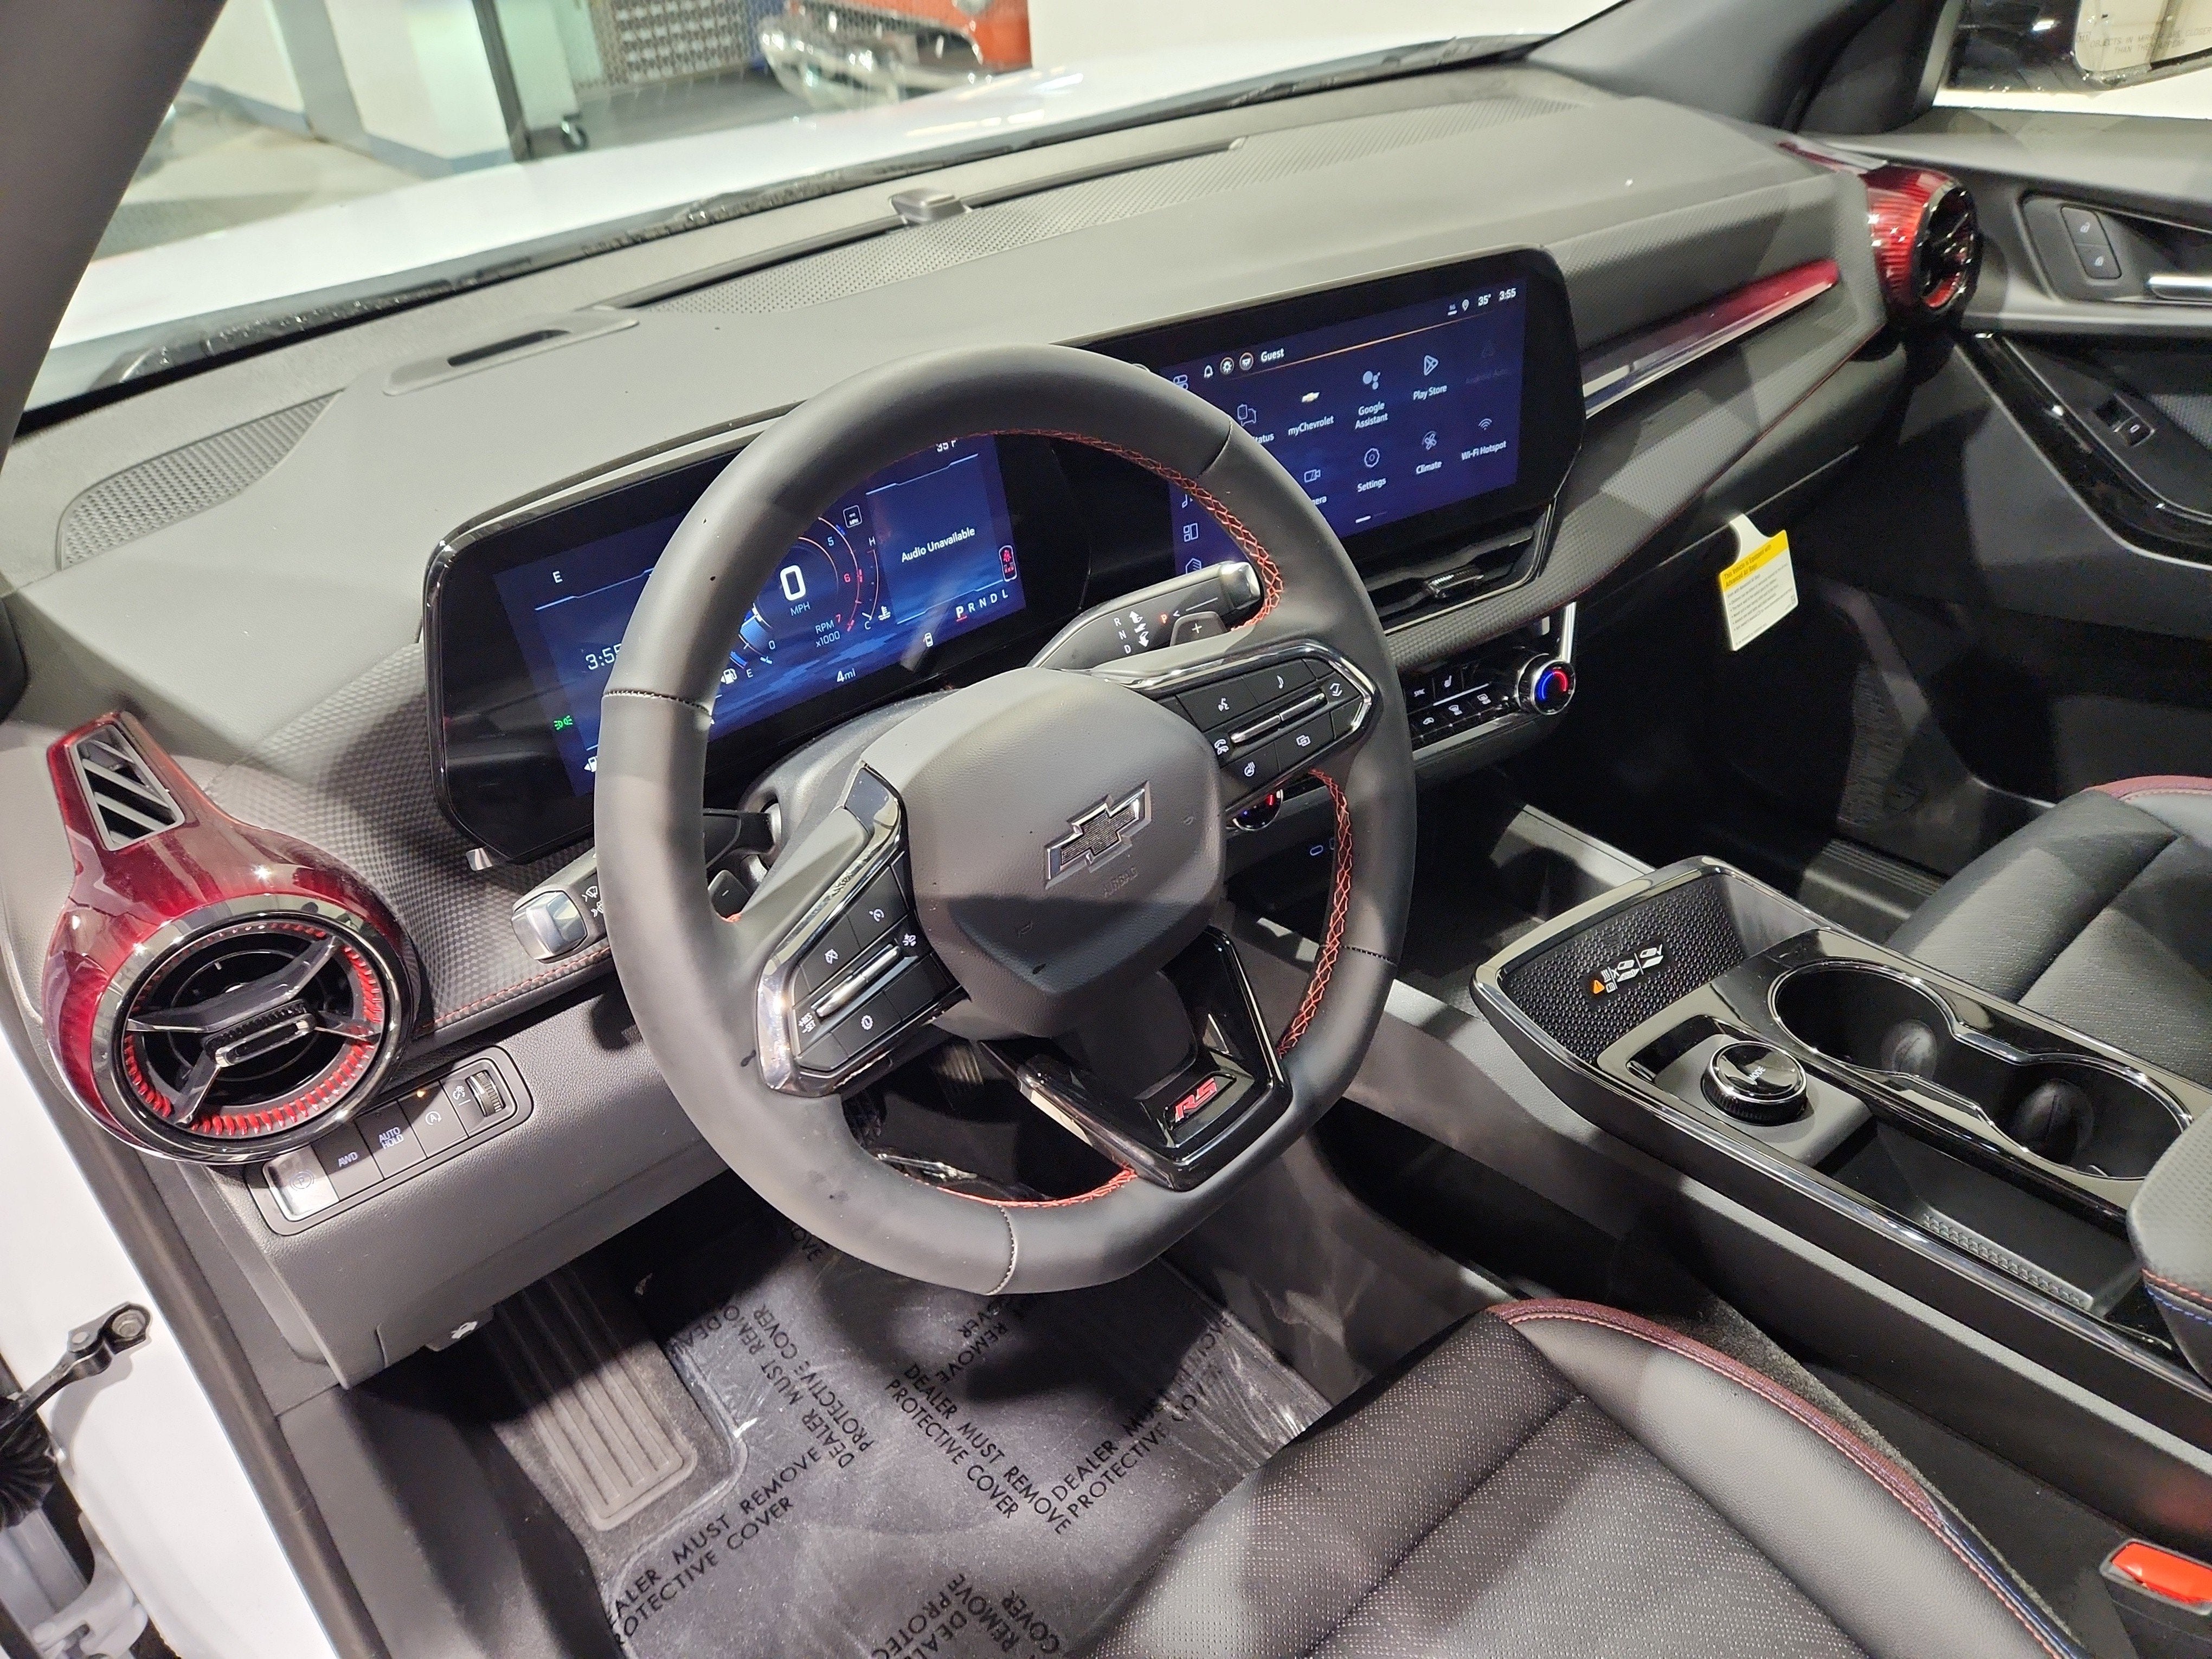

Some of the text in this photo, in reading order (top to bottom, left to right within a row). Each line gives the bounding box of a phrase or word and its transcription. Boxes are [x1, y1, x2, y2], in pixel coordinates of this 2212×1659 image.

[1478, 293, 1491, 306] 35°
[1499, 287, 1516, 302] 3:55
[1261, 348, 1285, 363] Guest
[1413, 384, 1448, 400] Play Store
[1358, 401, 1385, 417] Google
[1288, 415, 1334, 436] myChevrolet
[1355, 413, 1388, 429] Assistant
[1461, 440, 1507, 461] Wi-Fi Hotspot
[1416, 460, 1442, 475] Climate
[1357, 477, 1387, 493] Settings
[827, 536, 834, 546] 5
[869, 536, 876, 546] H
[901, 526, 976, 563] Audio Unavailable
[552, 570, 562, 584] E
[780, 565, 806, 601] 0
[843, 573, 851, 583] 6
[790, 601, 811, 616] MPH
[956, 589, 1009, 619] P R N D L
[835, 613, 843, 623] 7
[864, 621, 871, 631] C
[1114, 616, 1122, 627] R
[1161, 613, 1168, 624] P
[815, 620, 835, 634] RPM
[1118, 629, 1127, 640] N
[815, 630, 841, 648] x1000
[1124, 644, 1131, 654] D
[746, 667, 753, 678] E
[1175, 1077, 1217, 1123] RS
[379, 1127, 401, 1143] AUTO
[381, 1133, 405, 1150] HOLD
[338, 1151, 359, 1167] AWD
[934, 1323, 1008, 1384] REMOVE
[753, 1303, 876, 1453] PROTECTIVE COVER
[723, 1306, 855, 1469] DEALER MUST REMO
[885, 1379, 1020, 1520] PROTECTIVE COVER
[904, 1362, 1072, 1535] DEALER MUST REMOVE
[1051, 1439, 1119, 1502] DEALER
[672, 1513, 730, 1565] MUST
[740, 1445, 822, 1513] REMOVE
[614, 1496, 795, 1650] ROTECTIVE COVER
[947, 1573, 1020, 1653] REMOVE
[871, 1591, 952, 1659] PROTEC
[1001, 1590, 1060, 1654] COVER
[910, 1610, 968, 1659] DEAL
